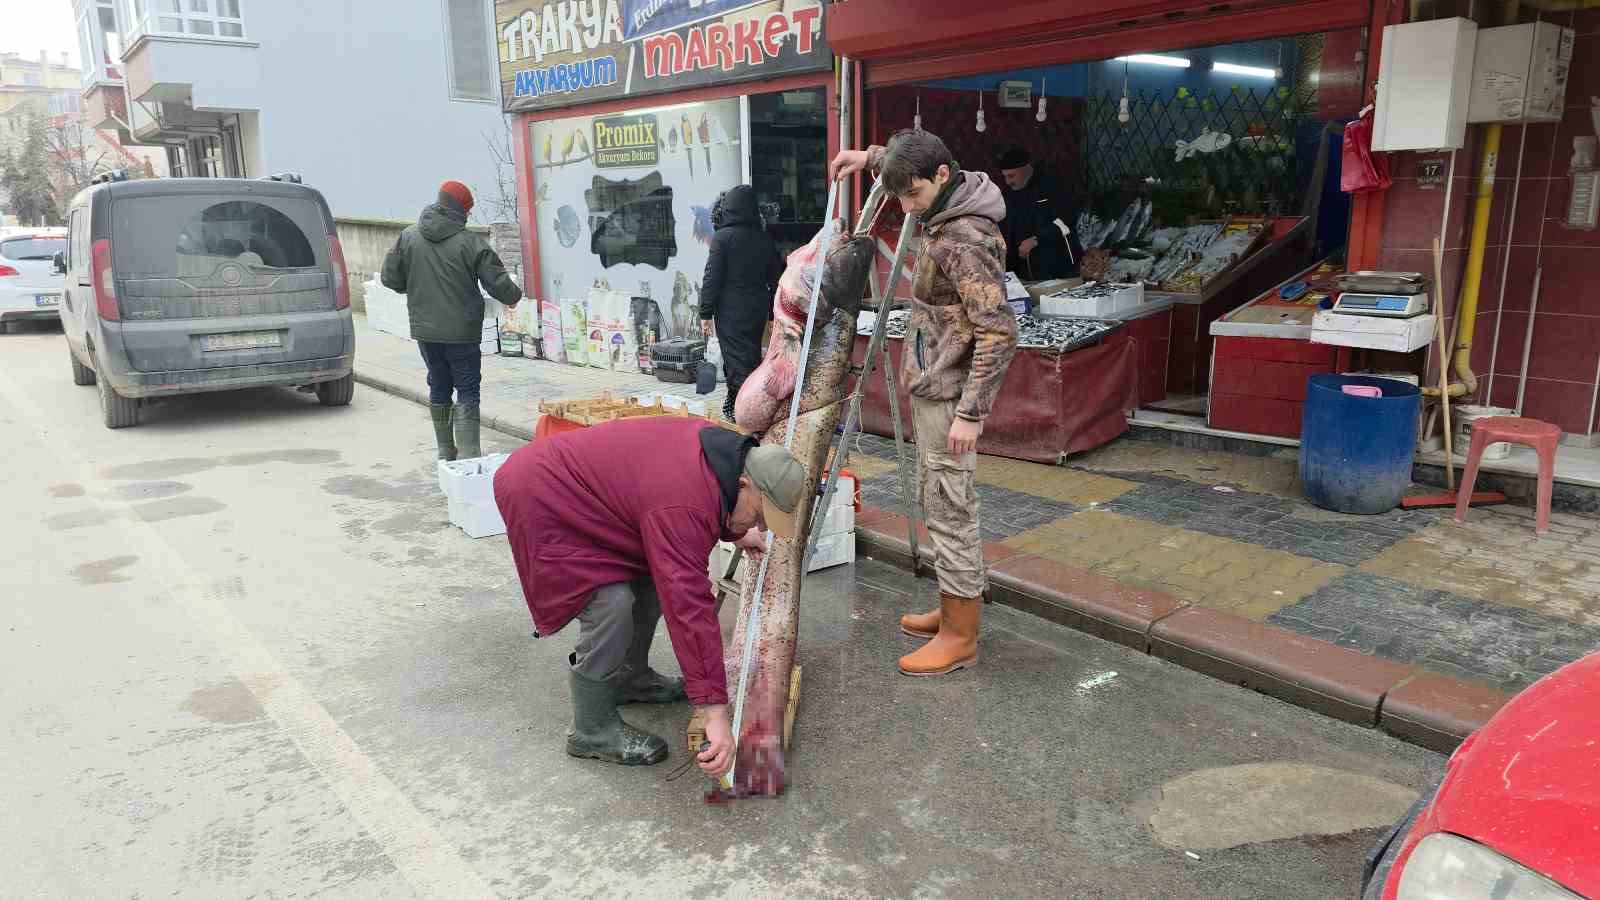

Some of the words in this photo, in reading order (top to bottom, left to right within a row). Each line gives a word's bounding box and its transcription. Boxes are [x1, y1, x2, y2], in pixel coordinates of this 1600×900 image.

[503, 0, 624, 62] TRAKYA
[643, 6, 820, 78] MARKET
[514, 55, 618, 97] AKVARYUM
[595, 121, 656, 148] Promix
[1424, 165, 1439, 176] 17
